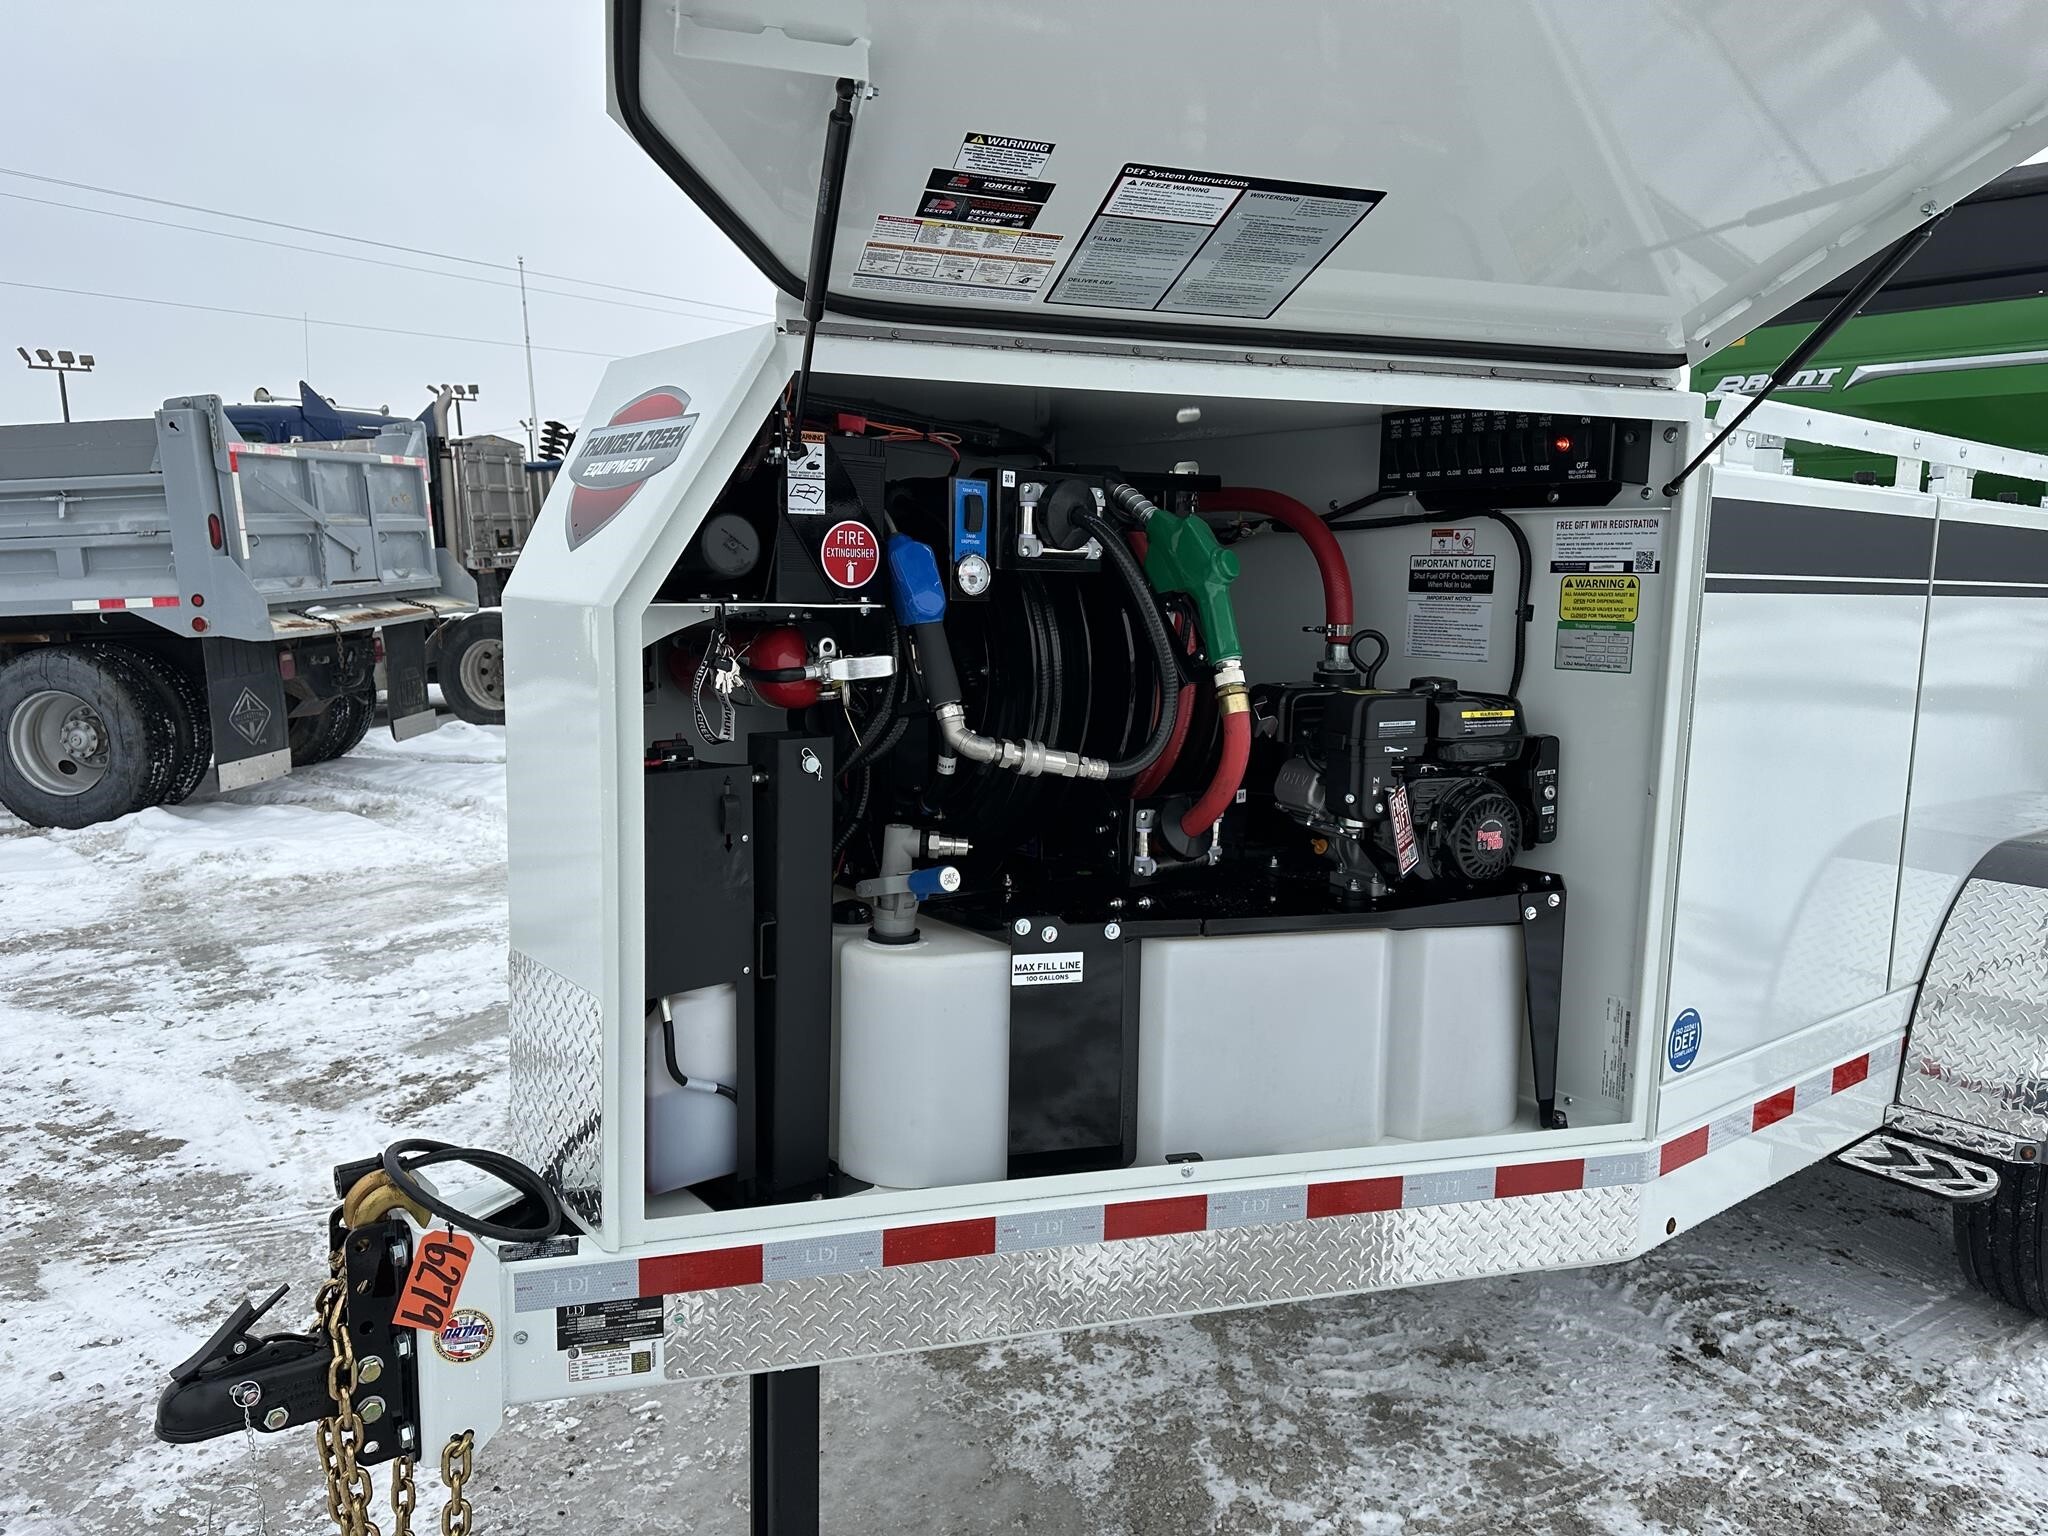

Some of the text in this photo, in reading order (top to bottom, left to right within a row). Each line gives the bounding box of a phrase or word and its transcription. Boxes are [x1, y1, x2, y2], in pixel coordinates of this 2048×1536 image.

[987, 136, 1050, 152] WARNING
[1124, 166, 1250, 188] DEF System Instructions
[983, 181, 1026, 192] TORFLEX
[1140, 180, 1210, 194] FREEZE WARNING
[1250, 192, 1300, 203] WINTERIZING
[923, 207, 952, 216] DEXTER
[970, 208, 1024, 220] NEV-R-ADJUST
[982, 216, 1002, 224] LUBE
[1093, 235, 1122, 243] FILLING
[1067, 276, 1098, 284] DELIVER
[1713, 367, 1842, 392] BRNT
[579, 425, 691, 458] THUNDER CREEK
[802, 432, 824, 442] ARNING
[582, 456, 656, 478] EQUIPMENT
[1576, 461, 1589, 469] OFF
[1556, 519, 1659, 530] FREE GIFT WITH REGISTRATION
[837, 531, 864, 546] FIRE
[826, 547, 874, 558] EXTINGUISHER
[1414, 559, 1491, 568] IMPORTANT NOTICE
[1414, 572, 1426, 580] Shut
[1426, 572, 1438, 580] Fuel
[1575, 579, 1624, 588] WARNING
[1391, 790, 1406, 817] FREE
[1394, 806, 1409, 834] GIFT
[1477, 830, 1501, 842] Power
[1487, 838, 1503, 850] PRO
[943, 876, 958, 886] ONLY
[945, 872, 956, 880] DEF
[1014, 961, 1080, 972] MAX FILL LINE
[1675, 1027, 1683, 1035] ISO
[1674, 1030, 1696, 1052] DEF
[1674, 1046, 1695, 1059] COMPLIANT
[805, 1244, 837, 1267] LDJ
[401, 1242, 467, 1330] 6279
[553, 1275, 589, 1294] LDJ
[566, 1305, 586, 1317] LDJ
